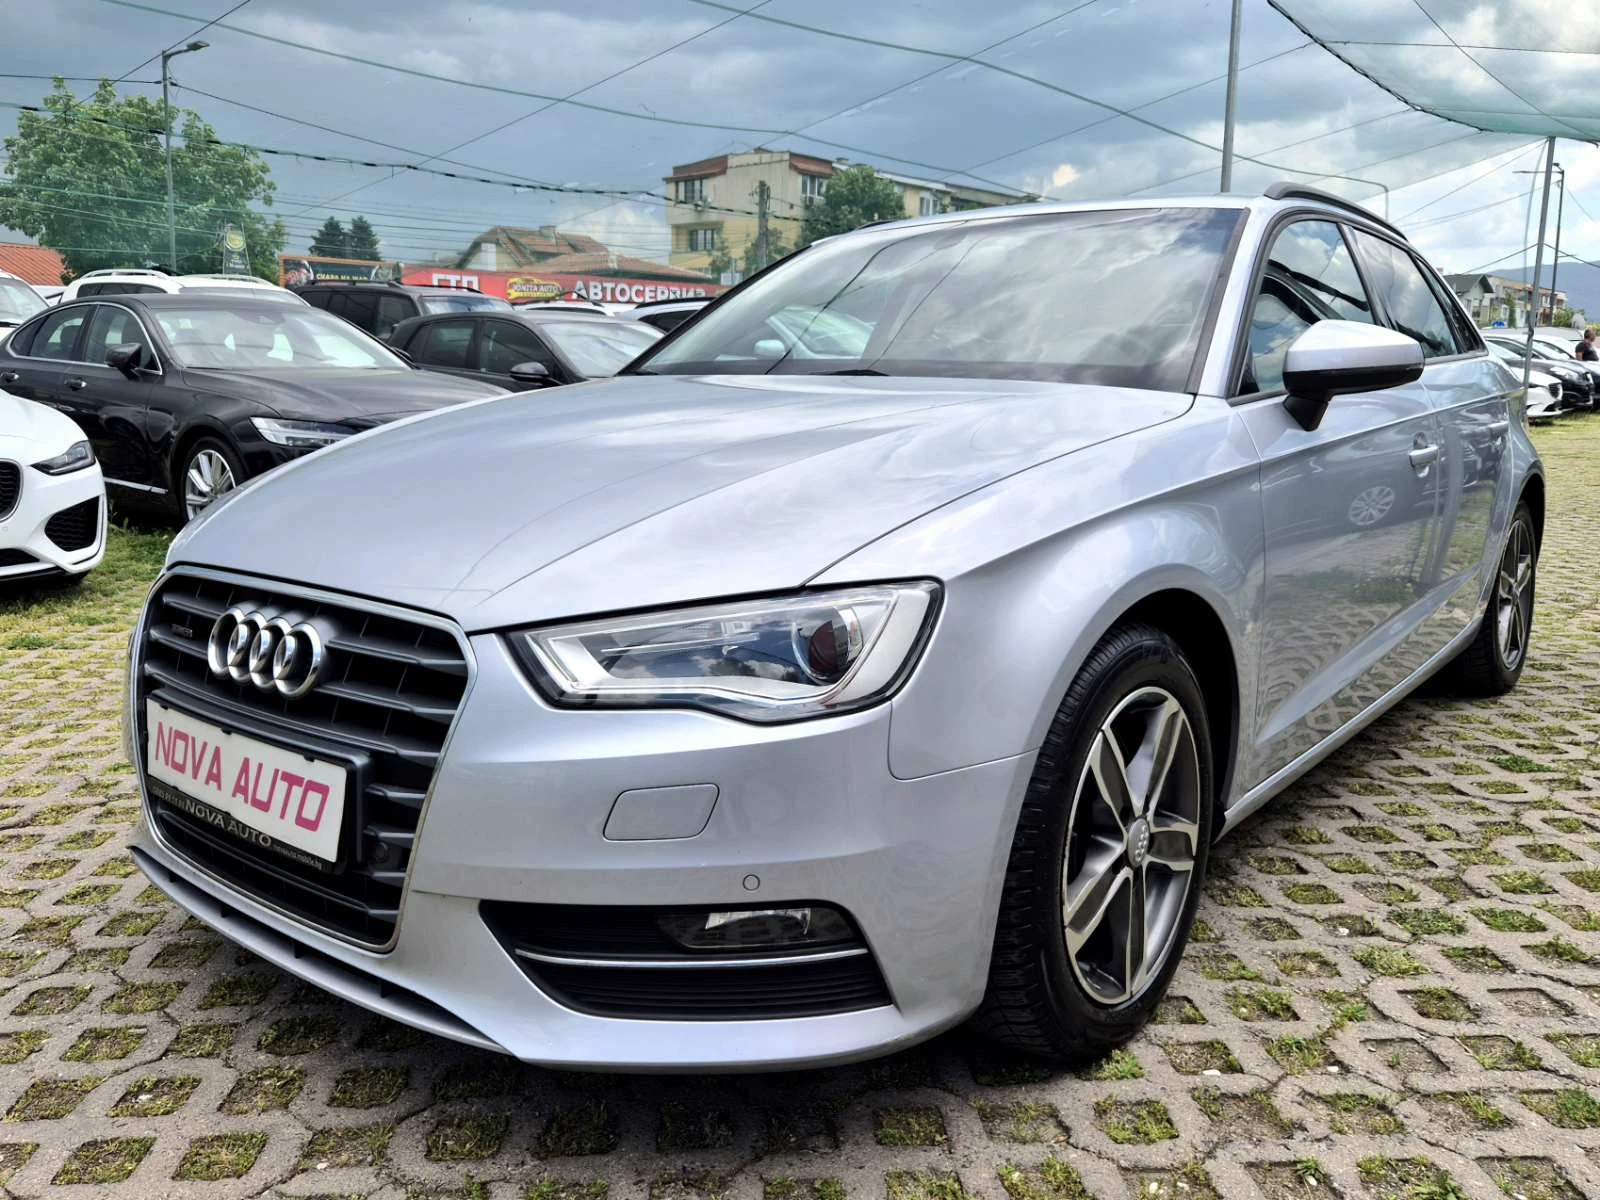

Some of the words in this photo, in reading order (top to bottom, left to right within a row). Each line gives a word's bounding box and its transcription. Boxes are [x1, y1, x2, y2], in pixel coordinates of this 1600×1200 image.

[432, 273, 479, 291] ГТП
[155, 721, 222, 791] NOVA
[231, 757, 330, 832] AUTO
[185, 800, 225, 829] NOVA
[227, 820, 271, 847] AUTO
